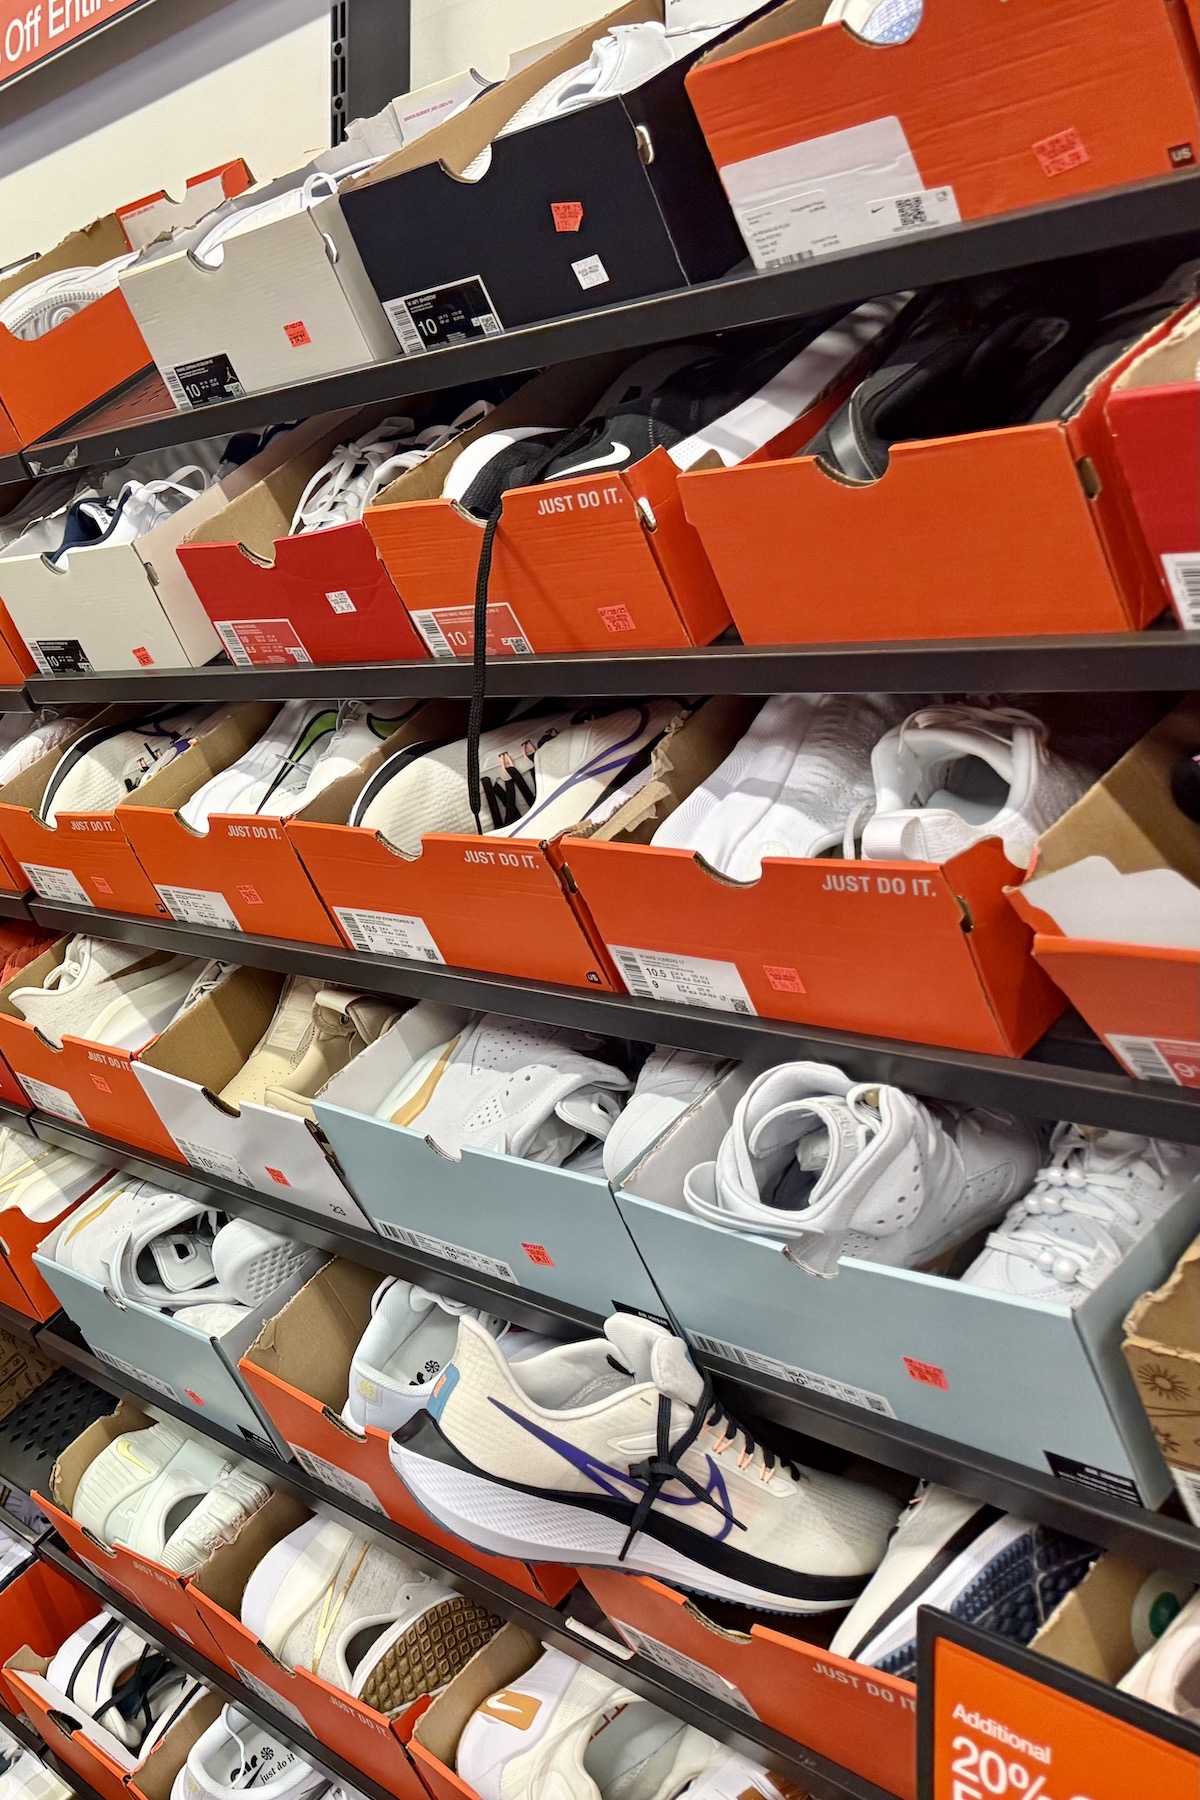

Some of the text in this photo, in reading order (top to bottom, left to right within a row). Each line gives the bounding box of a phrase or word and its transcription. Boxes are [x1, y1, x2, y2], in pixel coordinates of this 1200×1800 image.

[5, 4, 41, 62] Off
[1172, 147, 1192, 162] US
[418, 318, 438, 337] 10
[185, 383, 201, 399] 10
[537, 495, 574, 516] JUST
[577, 490, 601, 510] DO
[447, 631, 467, 646] 10
[46, 655, 60, 668] 10
[71, 820, 90, 831] JUST
[90, 821, 104, 832] DO
[227, 825, 251, 838] JUST
[252, 826, 267, 839] DO
[463, 850, 540, 870] JUST DO IT.
[822, 874, 937, 897] JUST DO IT.
[362, 924, 378, 933] 10.5
[367, 935, 374, 943] 9
[646, 967, 667, 979] 10.5
[652, 979, 659, 989] 9
[87, 1050, 107, 1065] JUST
[108, 1056, 121, 1069] DO
[441, 1244, 457, 1254] USA
[132, 1560, 153, 1577] JUST
[154, 1572, 169, 1586] DO
[812, 1661, 860, 1690] JUST
[866, 1683, 896, 1704] DO
[329, 1696, 356, 1718] JUST
[357, 1712, 375, 1729] DO
[952, 1703, 1052, 1765] Additional
[260, 1753, 295, 1786] just do it
[951, 1735, 1054, 1800] 20%
